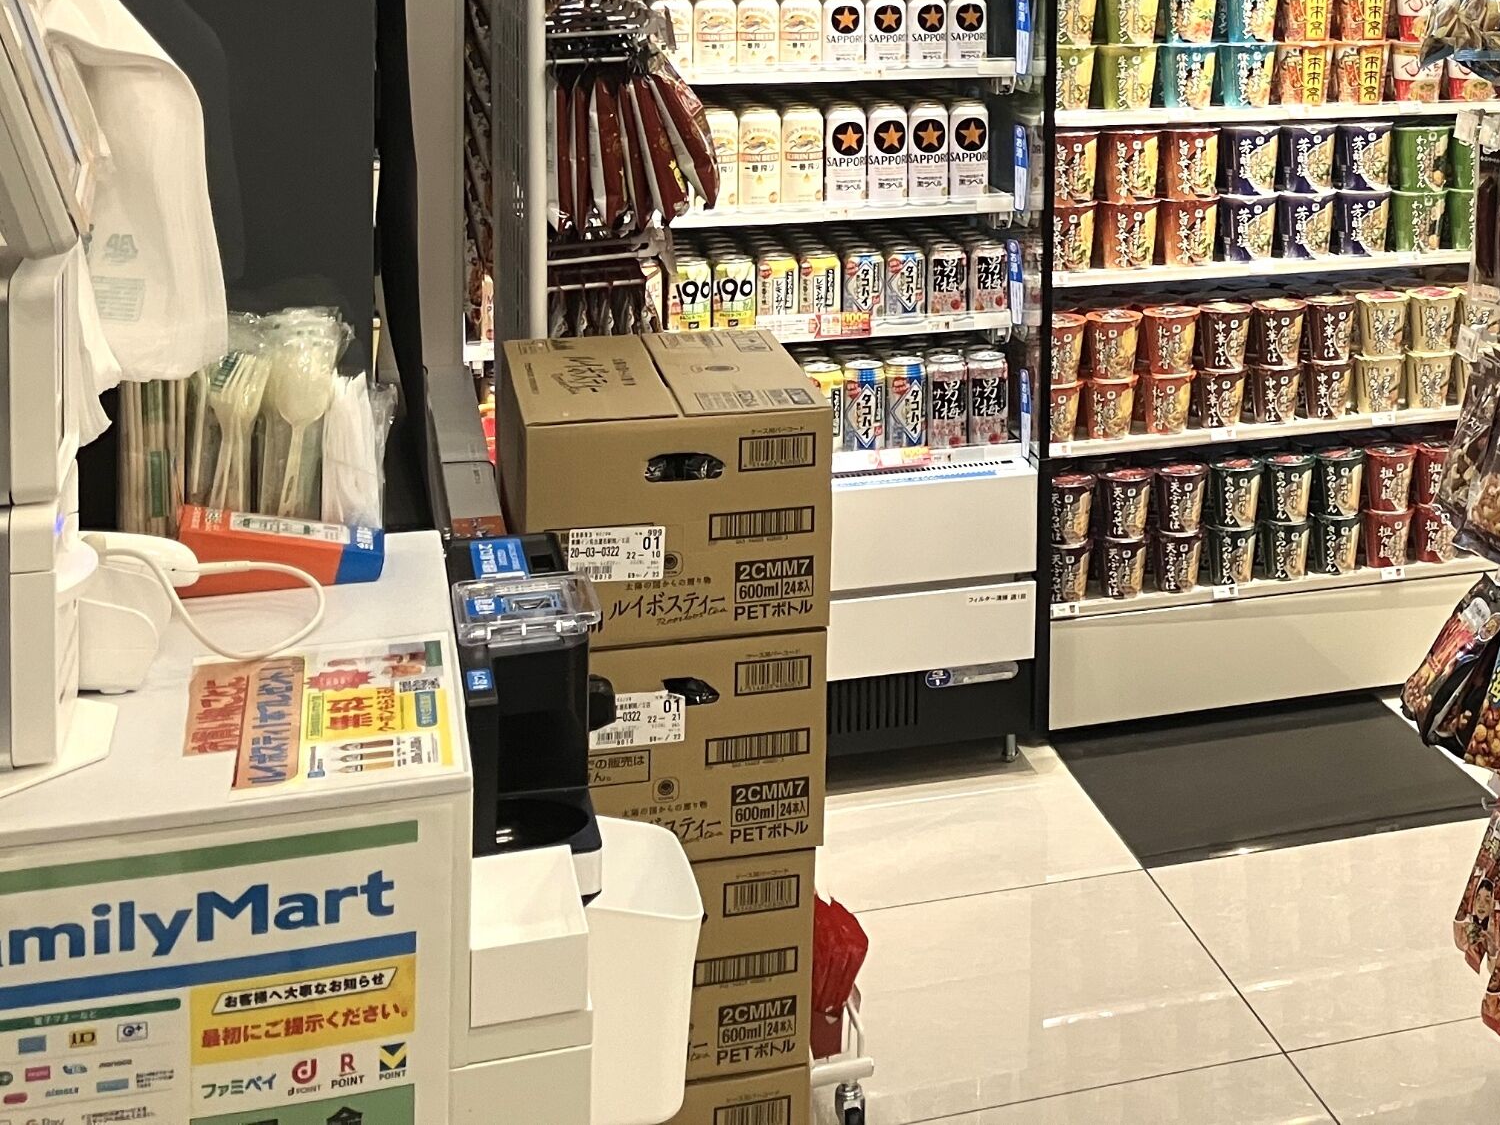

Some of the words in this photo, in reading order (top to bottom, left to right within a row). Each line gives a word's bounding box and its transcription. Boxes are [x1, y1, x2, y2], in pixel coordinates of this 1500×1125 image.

[570, 546, 621, 559] 20-03-0322
[642, 536, 662, 551] 01
[738, 557, 811, 581] 2CMM7
[738, 580, 780, 599] 600ml
[783, 579, 811, 596] 24本入
[609, 591, 727, 622] ルイボスティー
[734, 599, 813, 622] PETボトル
[663, 699, 681, 714] 01
[735, 779, 807, 804] 2CMM7
[734, 803, 775, 822] 600ml
[779, 801, 807, 817] 24本入
[730, 821, 809, 845] PETボトル
[223, 970, 387, 1009] お客様へ大事なお知らせ
[722, 998, 793, 1025] 2CMM7
[201, 1003, 409, 1049] 最初にご提示ください。
[722, 1023, 763, 1044] 600ml
[766, 1019, 794, 1036] 24本入
[716, 1038, 796, 1066] PETボトル
[201, 1072, 277, 1099] ファミペイ
[331, 1074, 365, 1089] POINT
[379, 1069, 407, 1082] POINT
